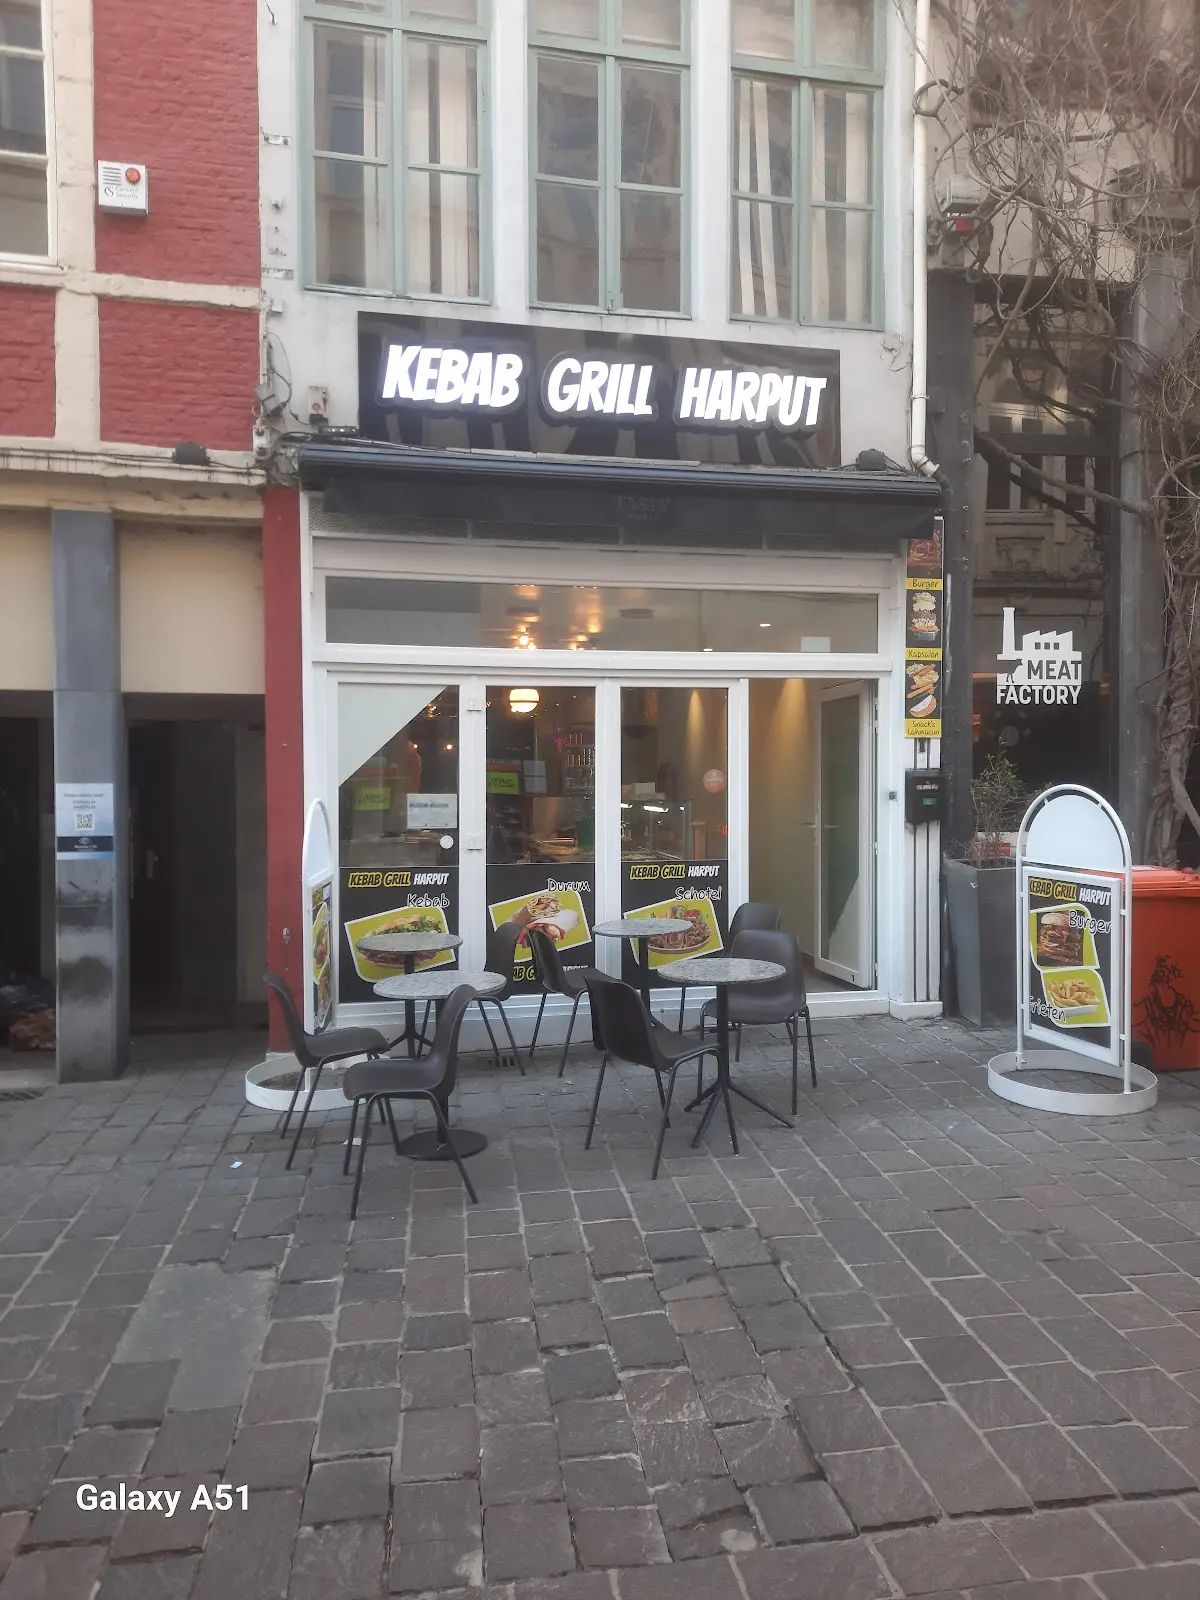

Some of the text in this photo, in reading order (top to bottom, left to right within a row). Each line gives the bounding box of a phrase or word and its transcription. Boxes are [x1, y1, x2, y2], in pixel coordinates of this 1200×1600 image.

[382, 344, 827, 426] KEBAB GRILL HARPUT
[912, 579, 939, 589] Burger
[908, 649, 939, 660] Kapsalon
[1027, 660, 1082, 680] MEAT
[996, 685, 1082, 705] FACTORY
[348, 872, 450, 888] KEBAB GRILL HARPUT
[630, 864, 720, 880] KEBAB GRILL HARPUT
[547, 878, 591, 893] Durum
[675, 886, 722, 901] Schotel
[407, 894, 450, 908] Kebab
[1054, 884, 1076, 900] GRILL
[1079, 887, 1111, 906] HARPUT
